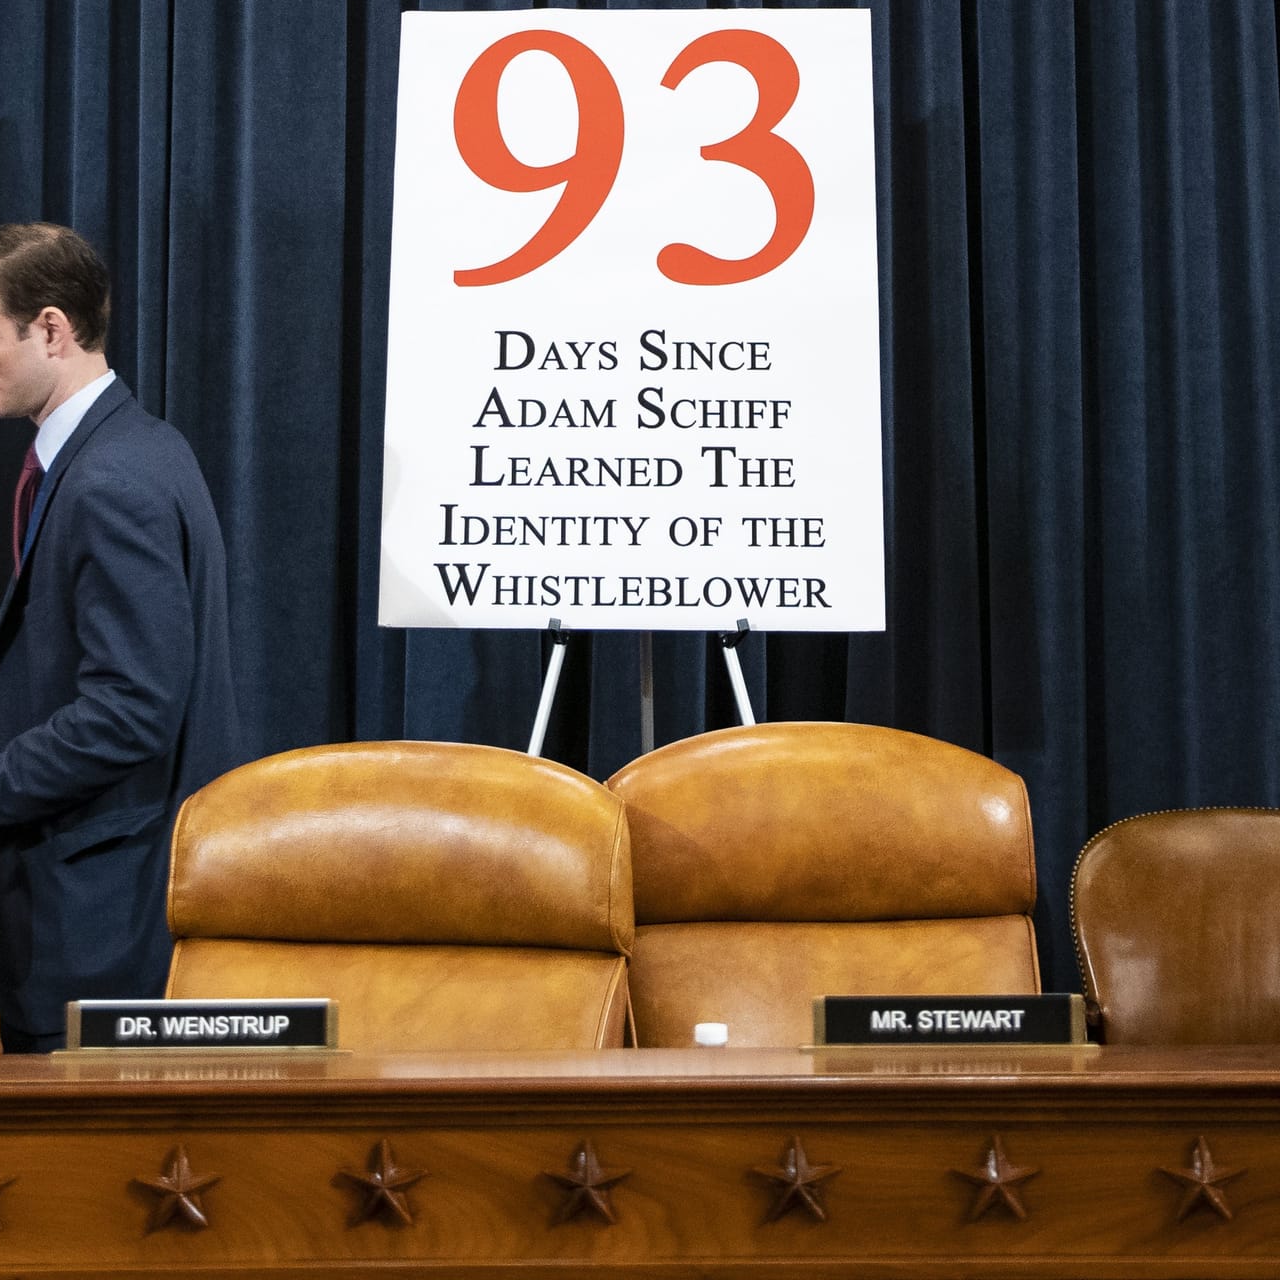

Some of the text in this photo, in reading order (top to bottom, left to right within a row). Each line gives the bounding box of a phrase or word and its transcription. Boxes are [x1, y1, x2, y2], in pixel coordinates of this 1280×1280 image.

[452, 28, 816, 288] 93
[119, 1015, 290, 1037] DR. WENSTRUP
[871, 1009, 1025, 1030] MR. STEWART
